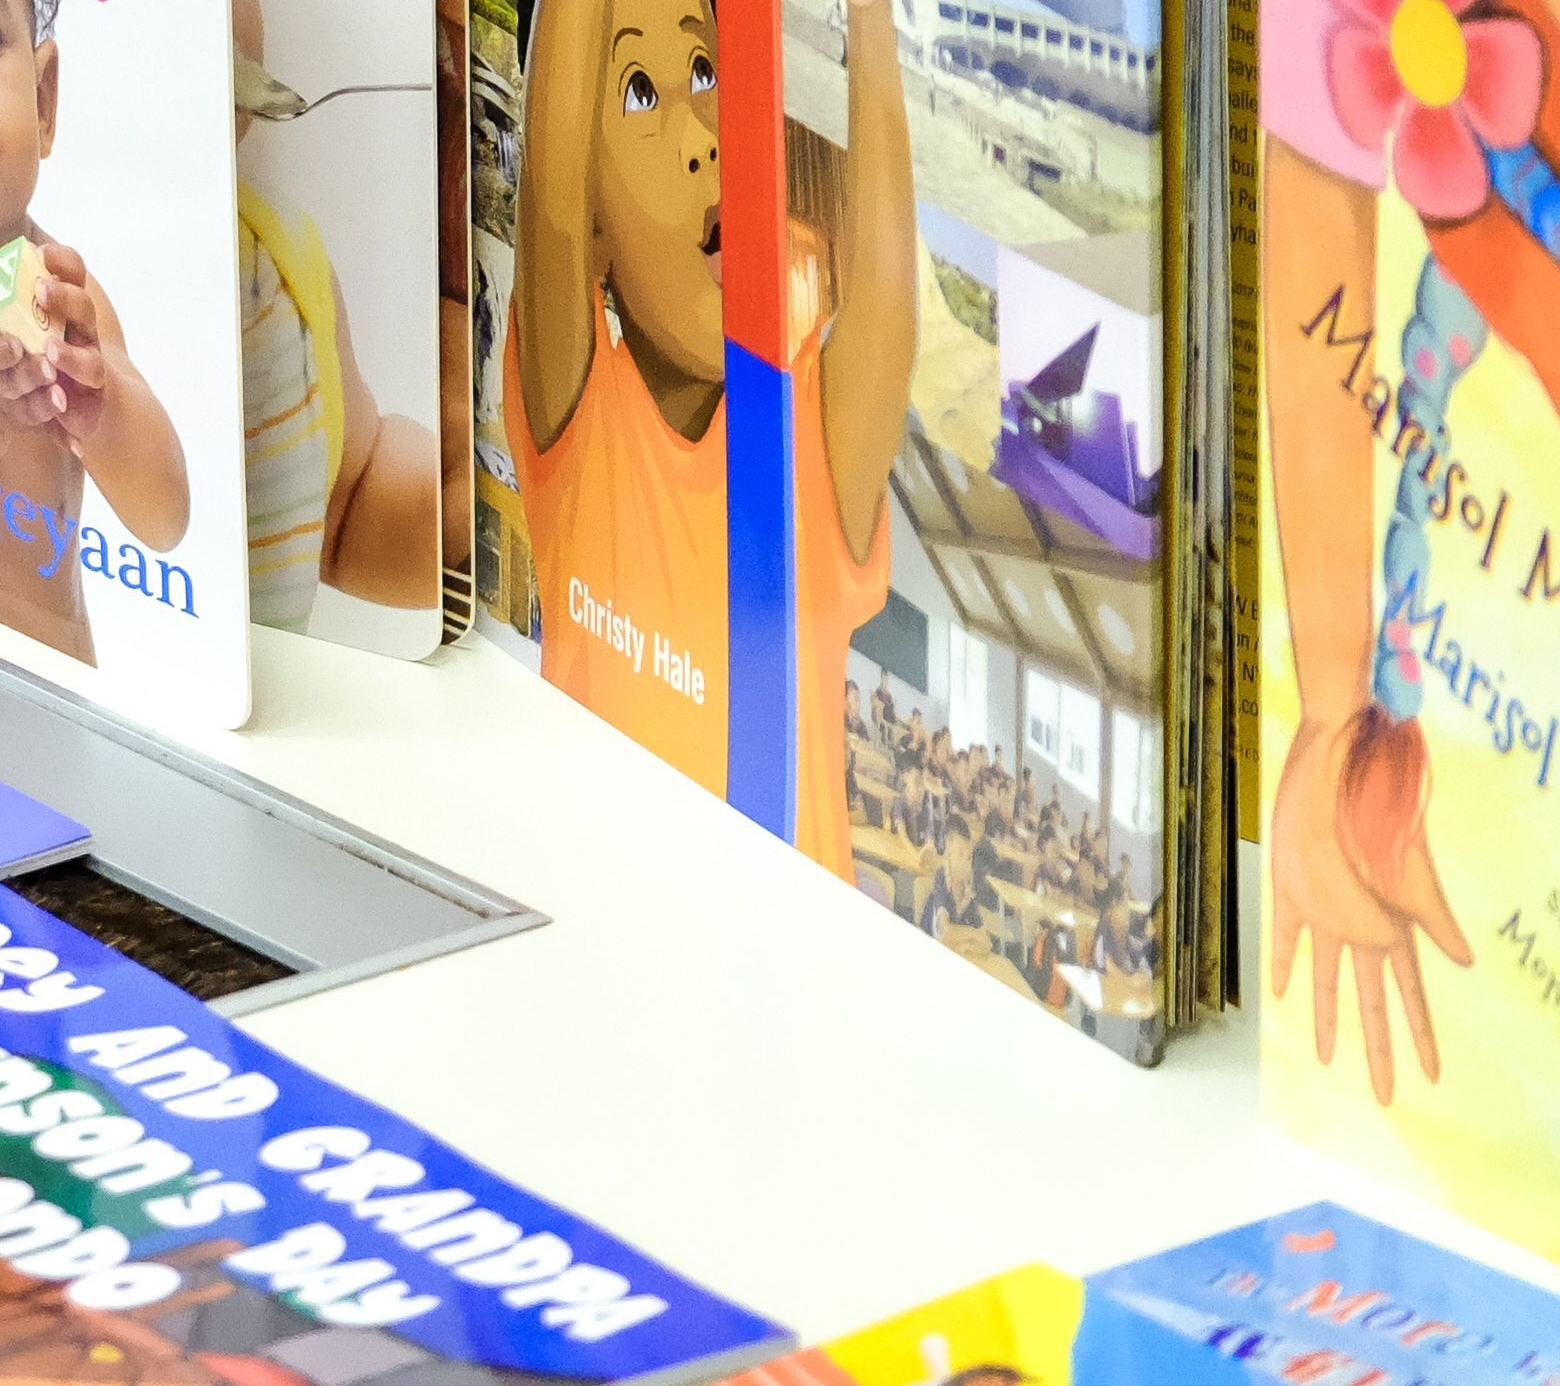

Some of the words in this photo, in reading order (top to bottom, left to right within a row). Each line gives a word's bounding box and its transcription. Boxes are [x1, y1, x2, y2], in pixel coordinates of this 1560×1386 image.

[1300, 283, 1510, 573] Marisol
[567, 575, 646, 673] Christy
[651, 633, 706, 706] Hale
[1383, 568, 1559, 788] Marisol
